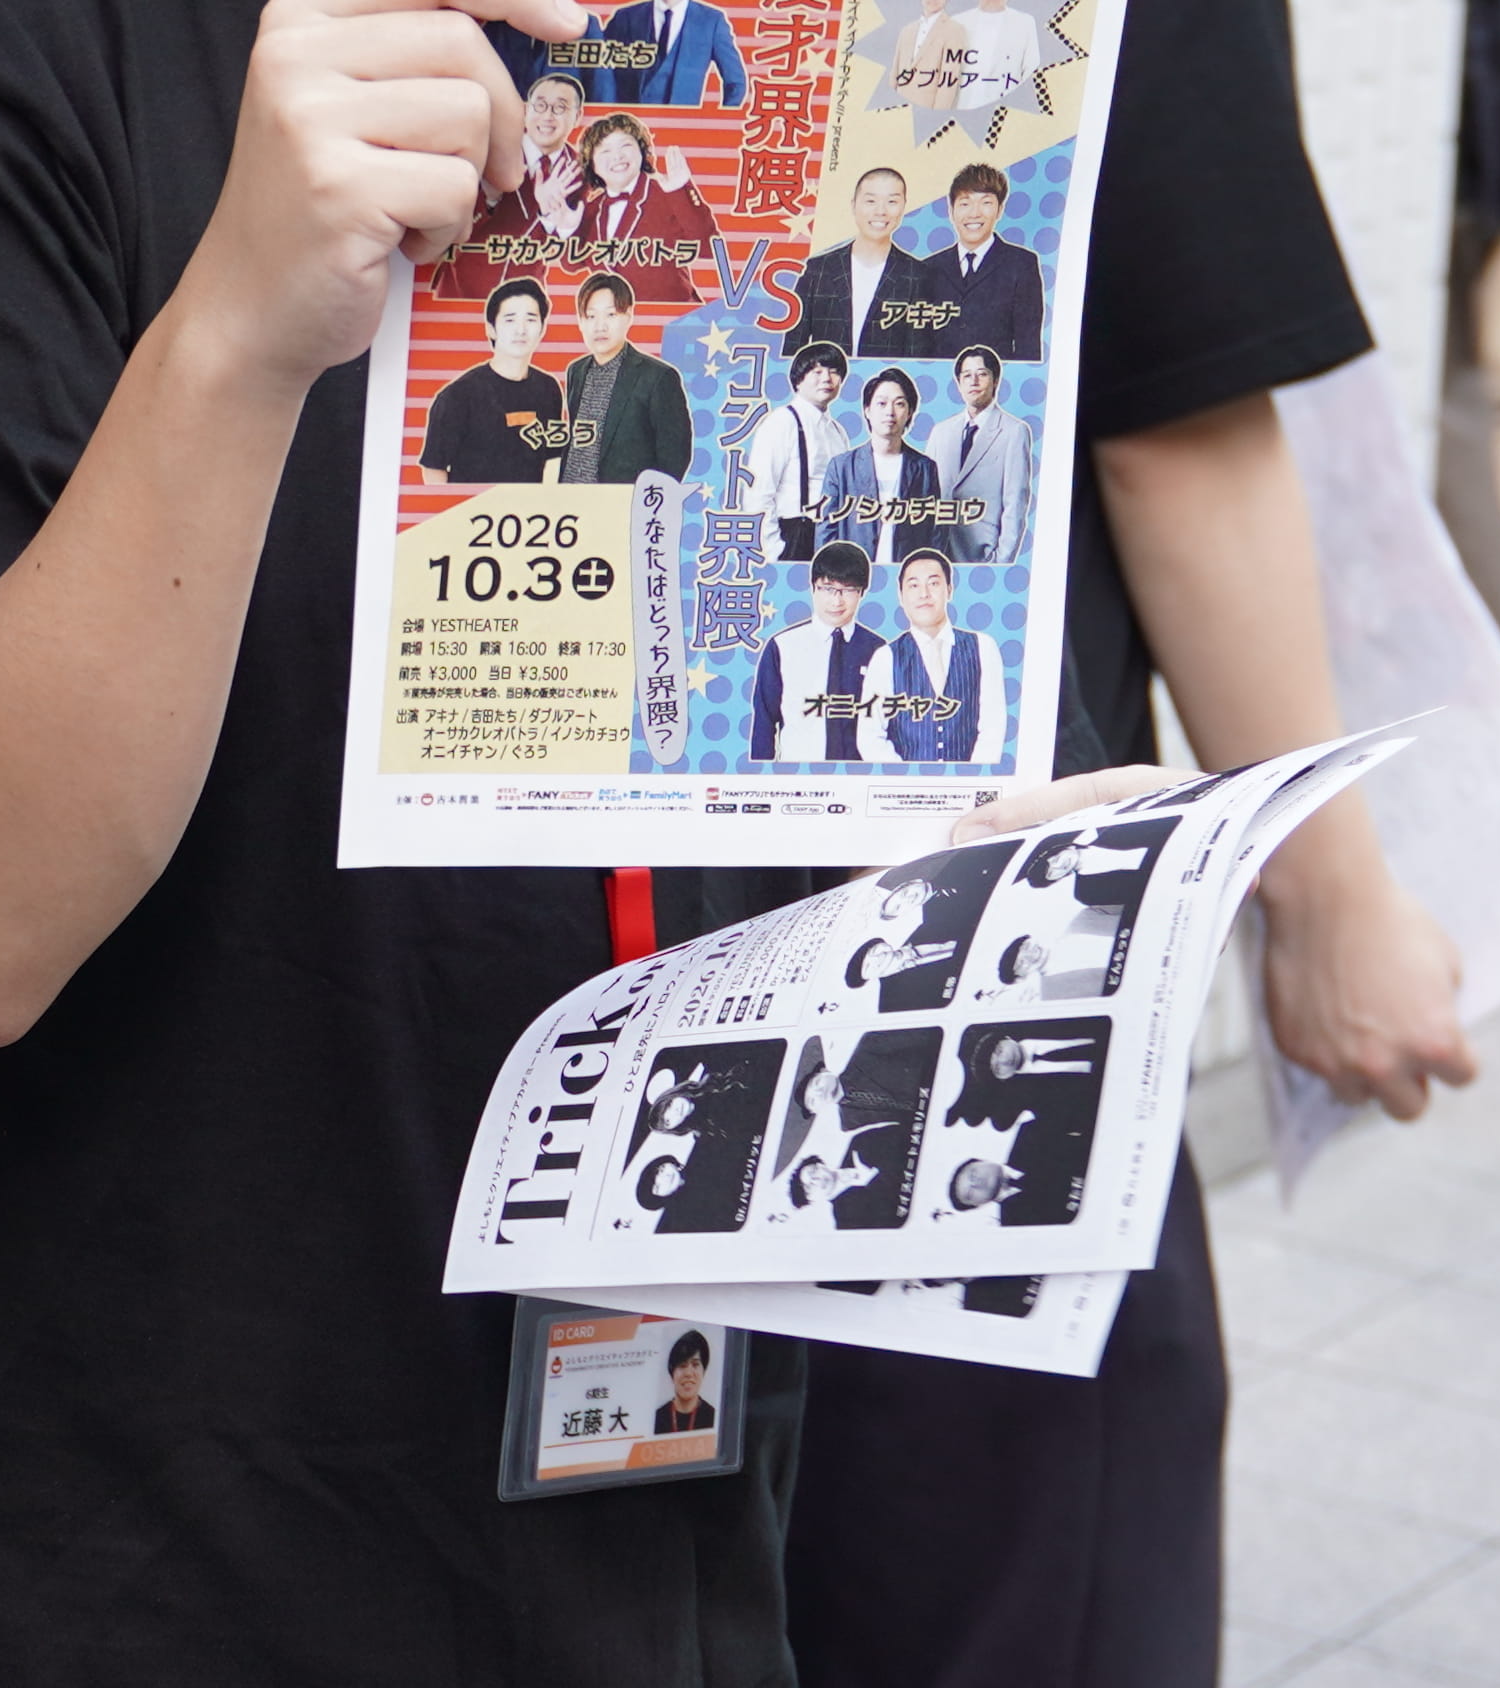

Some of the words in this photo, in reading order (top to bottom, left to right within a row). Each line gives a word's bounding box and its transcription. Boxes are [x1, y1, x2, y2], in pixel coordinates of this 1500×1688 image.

[549, 40, 658, 68] 吉田たち
[945, 49, 979, 65] MC
[896, 68, 1020, 90] ダブルアート
[712, 237, 806, 332] VS
[880, 301, 960, 330] アキナ
[520, 418, 597, 450] ぐろう
[691, 345, 769, 650] コント界隈
[802, 494, 987, 525] イノシカチョウ
[468, 514, 580, 548] 2026
[429, 555, 562, 602] 10.3
[402, 618, 425, 634] 会場
[431, 618, 519, 632] YESTHEATER
[430, 641, 468, 656] 15:30
[509, 641, 547, 656] 16:00
[588, 641, 626, 656] 17:30
[429, 666, 477, 682] ¥3,000
[488, 666, 512, 682] 当日
[519, 666, 568, 682] ¥3,500
[803, 693, 961, 722] オニイチャン
[528, 791, 560, 800] FANY
[644, 790, 693, 801] FamilyMart
[678, 970, 718, 1028] 2026
[495, 998, 639, 1245] Trick
[552, 1327, 564, 1341] ID
[566, 1325, 595, 1340] CARD
[608, 1406, 630, 1433] 大
[640, 1442, 707, 1462] OSAKA
